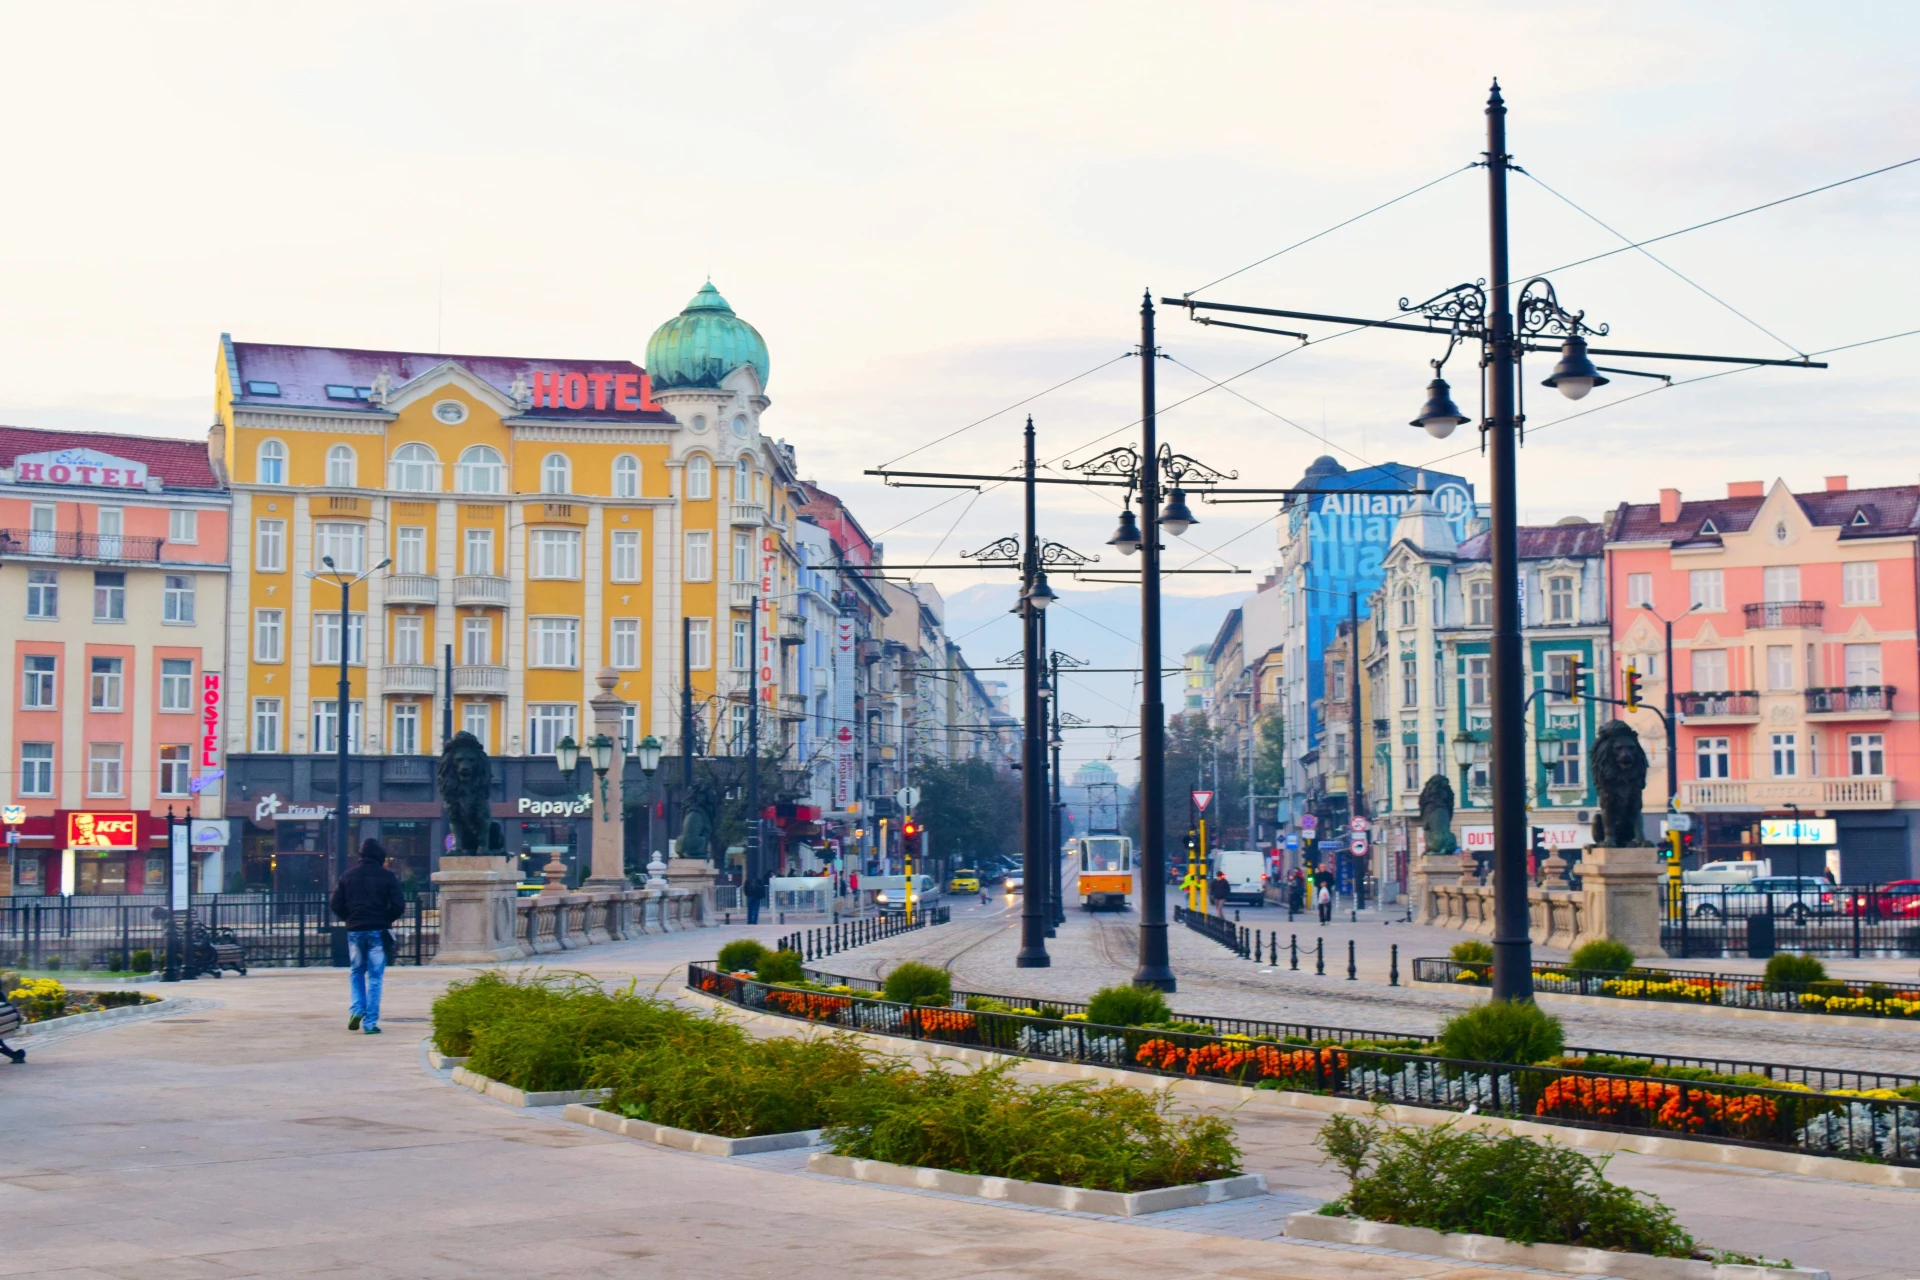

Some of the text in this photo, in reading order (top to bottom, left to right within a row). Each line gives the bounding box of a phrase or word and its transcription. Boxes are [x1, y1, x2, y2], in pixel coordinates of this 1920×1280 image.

[533, 371, 661, 412] HOTEL
[19, 462, 144, 488] HOTEL
[1320, 493, 1419, 515] Allian
[761, 626, 772, 702] LION
[202, 675, 219, 767] HOSTEL
[837, 753, 846, 802] Carrefour
[288, 804, 315, 814] Pizza
[518, 797, 585, 817] Papaya
[96, 820, 133, 833] KFC
[1542, 830, 1577, 843] TALY
[1467, 832, 1494, 845] OUT
